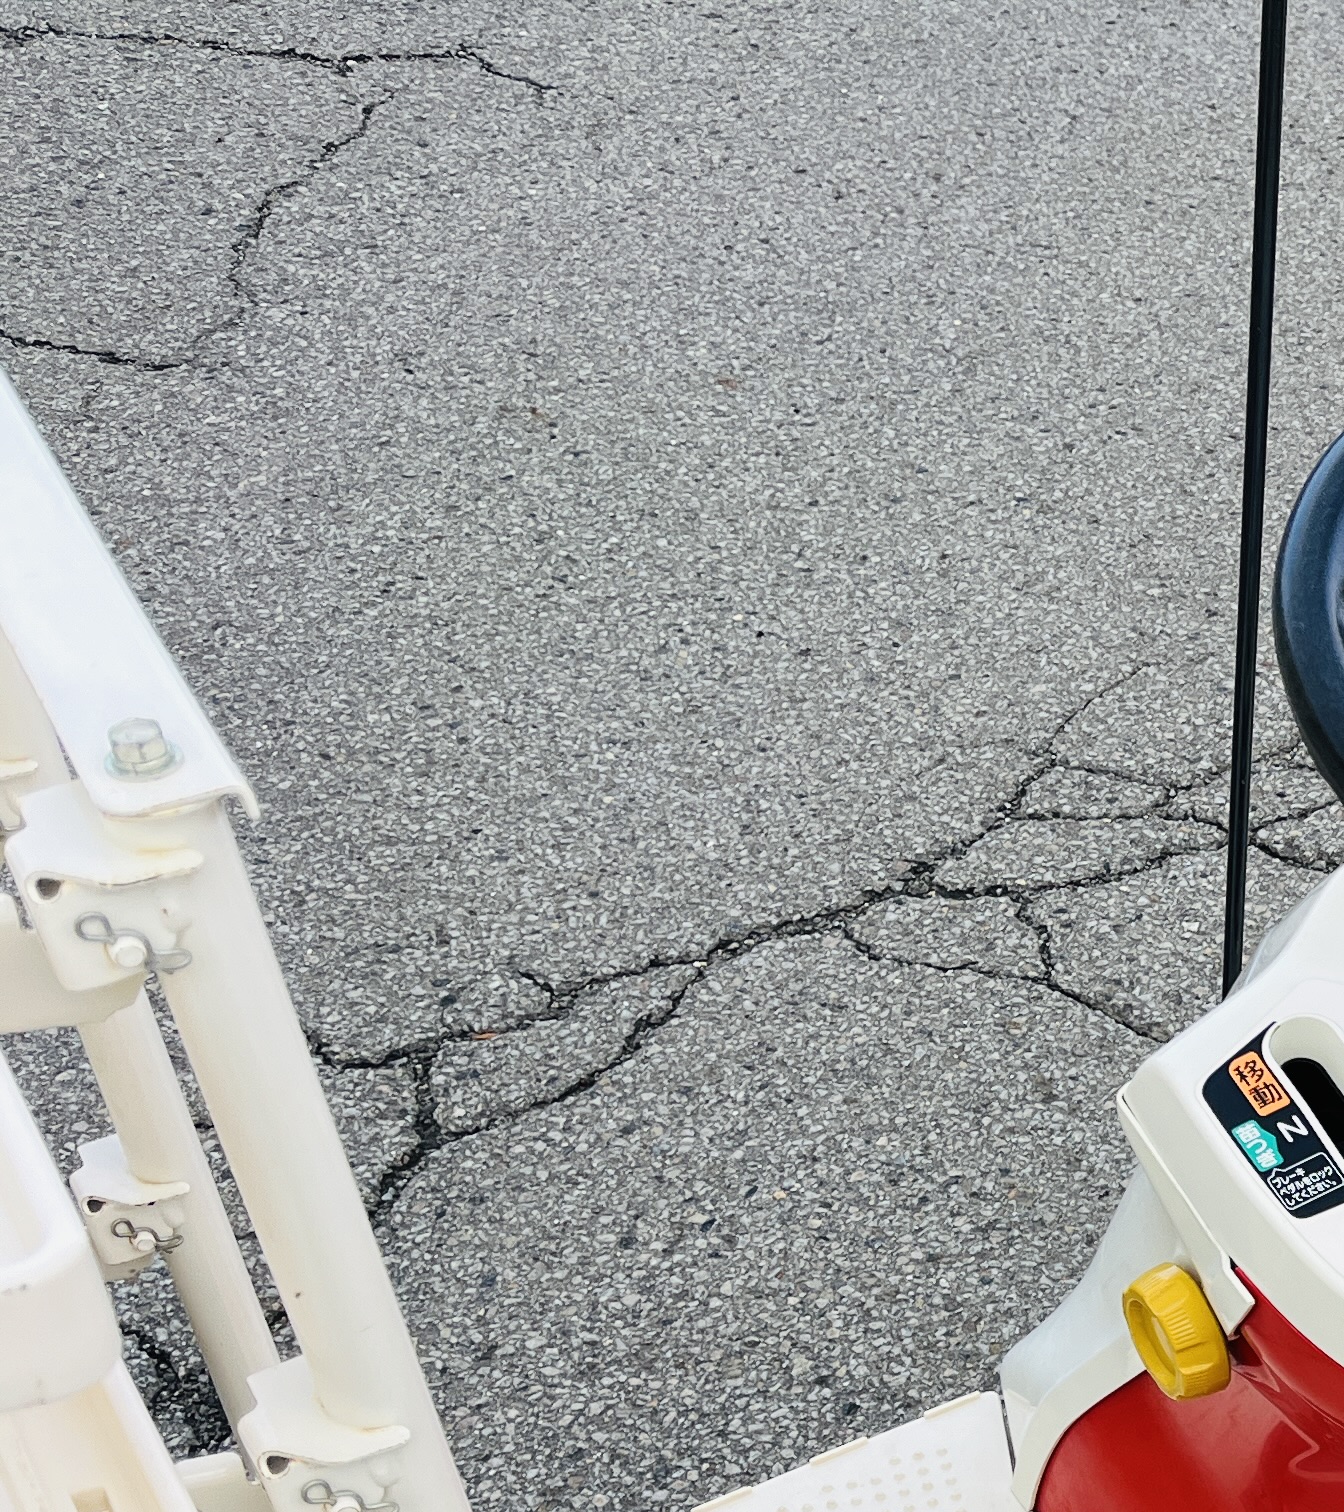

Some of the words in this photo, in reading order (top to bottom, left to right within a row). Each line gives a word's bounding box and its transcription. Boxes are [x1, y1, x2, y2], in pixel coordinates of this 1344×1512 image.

[1233, 1059, 1283, 1110] 移動
[1235, 1121, 1279, 1169] 苗つぎ
[1276, 1114, 1310, 1144] N
